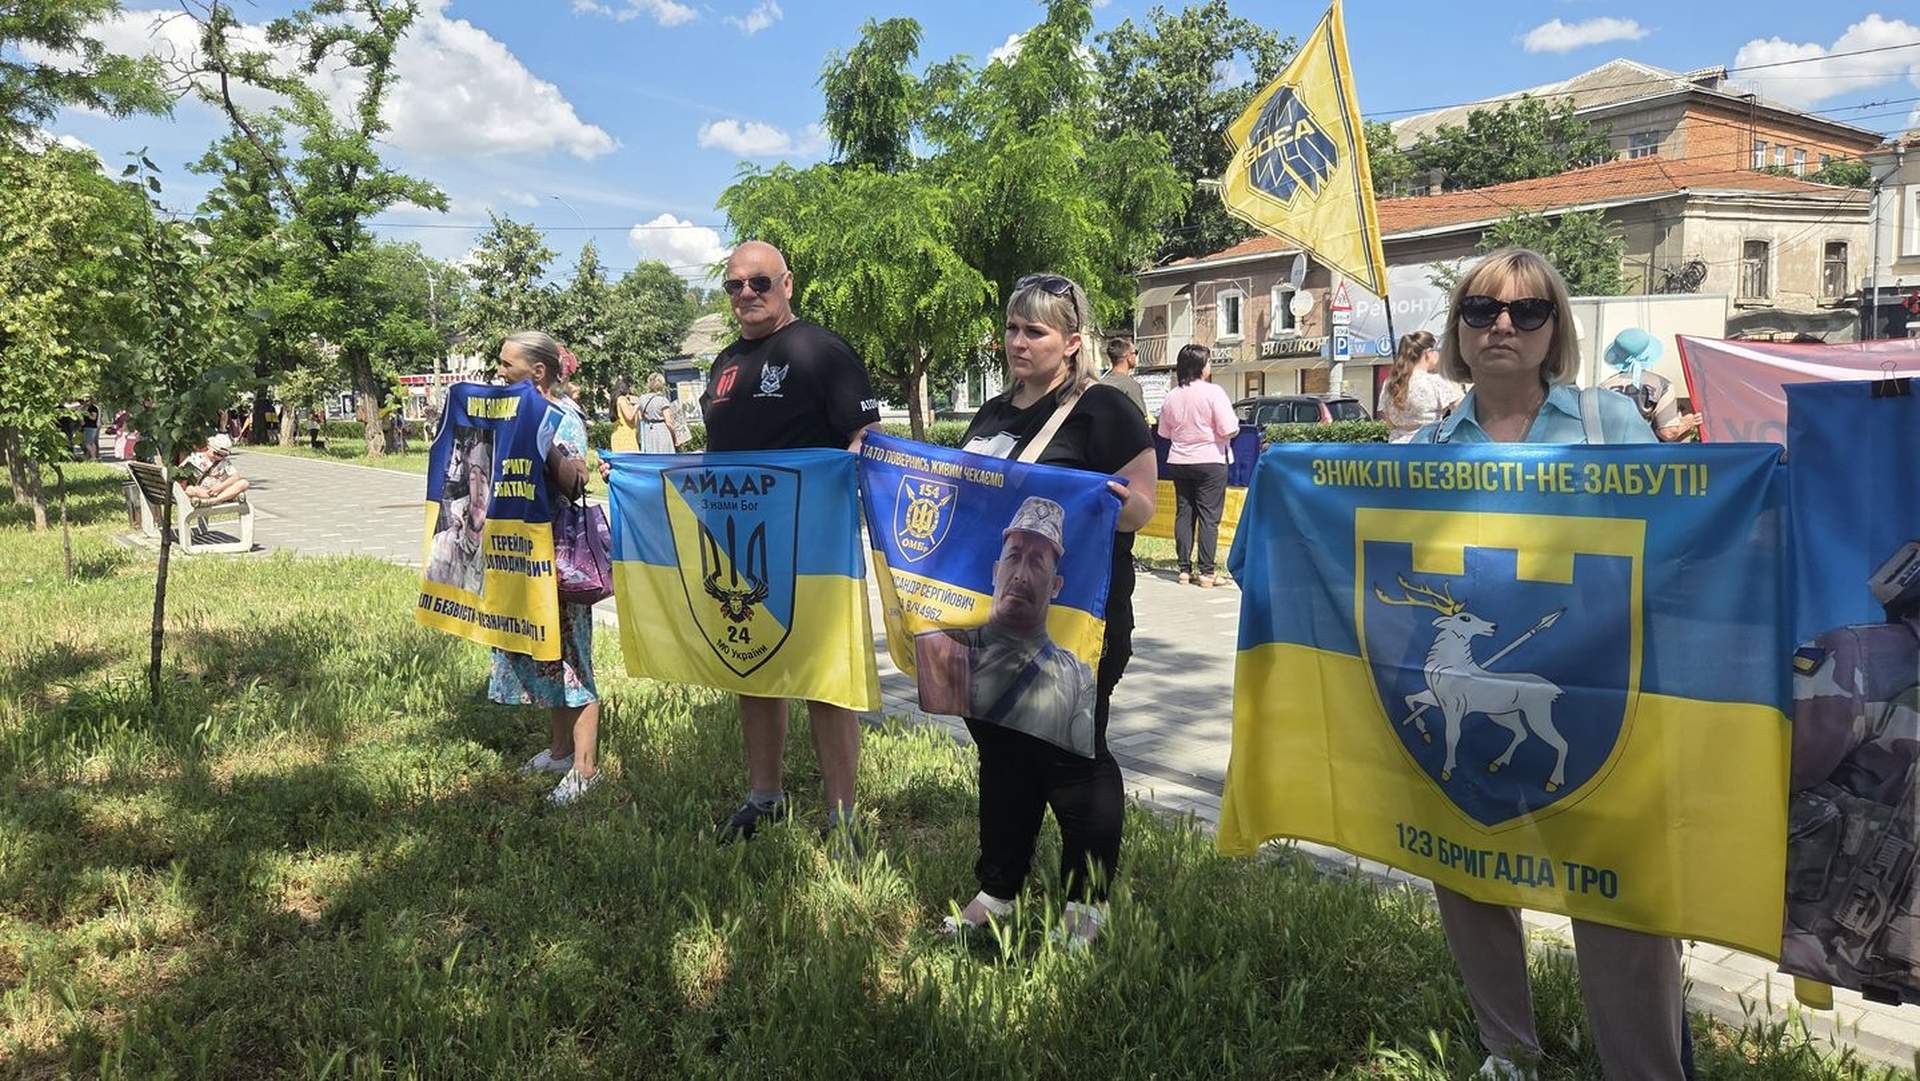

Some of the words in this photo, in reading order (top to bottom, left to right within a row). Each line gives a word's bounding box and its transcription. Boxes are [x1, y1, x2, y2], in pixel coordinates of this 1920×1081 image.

[862, 445, 885, 461] ТАТО
[884, 450, 930, 472] ПОВЕРНИСЬ
[930, 460, 963, 478] ЖИВИМ
[964, 466, 1005, 489] ЧЕКАЄМО
[1312, 459, 1400, 488] ЗНИКЛІ
[1408, 461, 1575, 493] БЕЗВІСТІ-НЕ
[1583, 462, 1709, 497] ЗАБУТІ!
[680, 467, 777, 498] АЙДАР
[919, 484, 940, 498] 154
[701, 499, 709, 510] З
[710, 501, 739, 510] нами
[740, 499, 759, 511] Бог
[727, 626, 752, 644] 24
[731, 643, 768, 661] України
[1396, 822, 1434, 858] 123
[1438, 836, 1556, 887] БРИГАДА
[1562, 861, 1618, 899] ТРО
